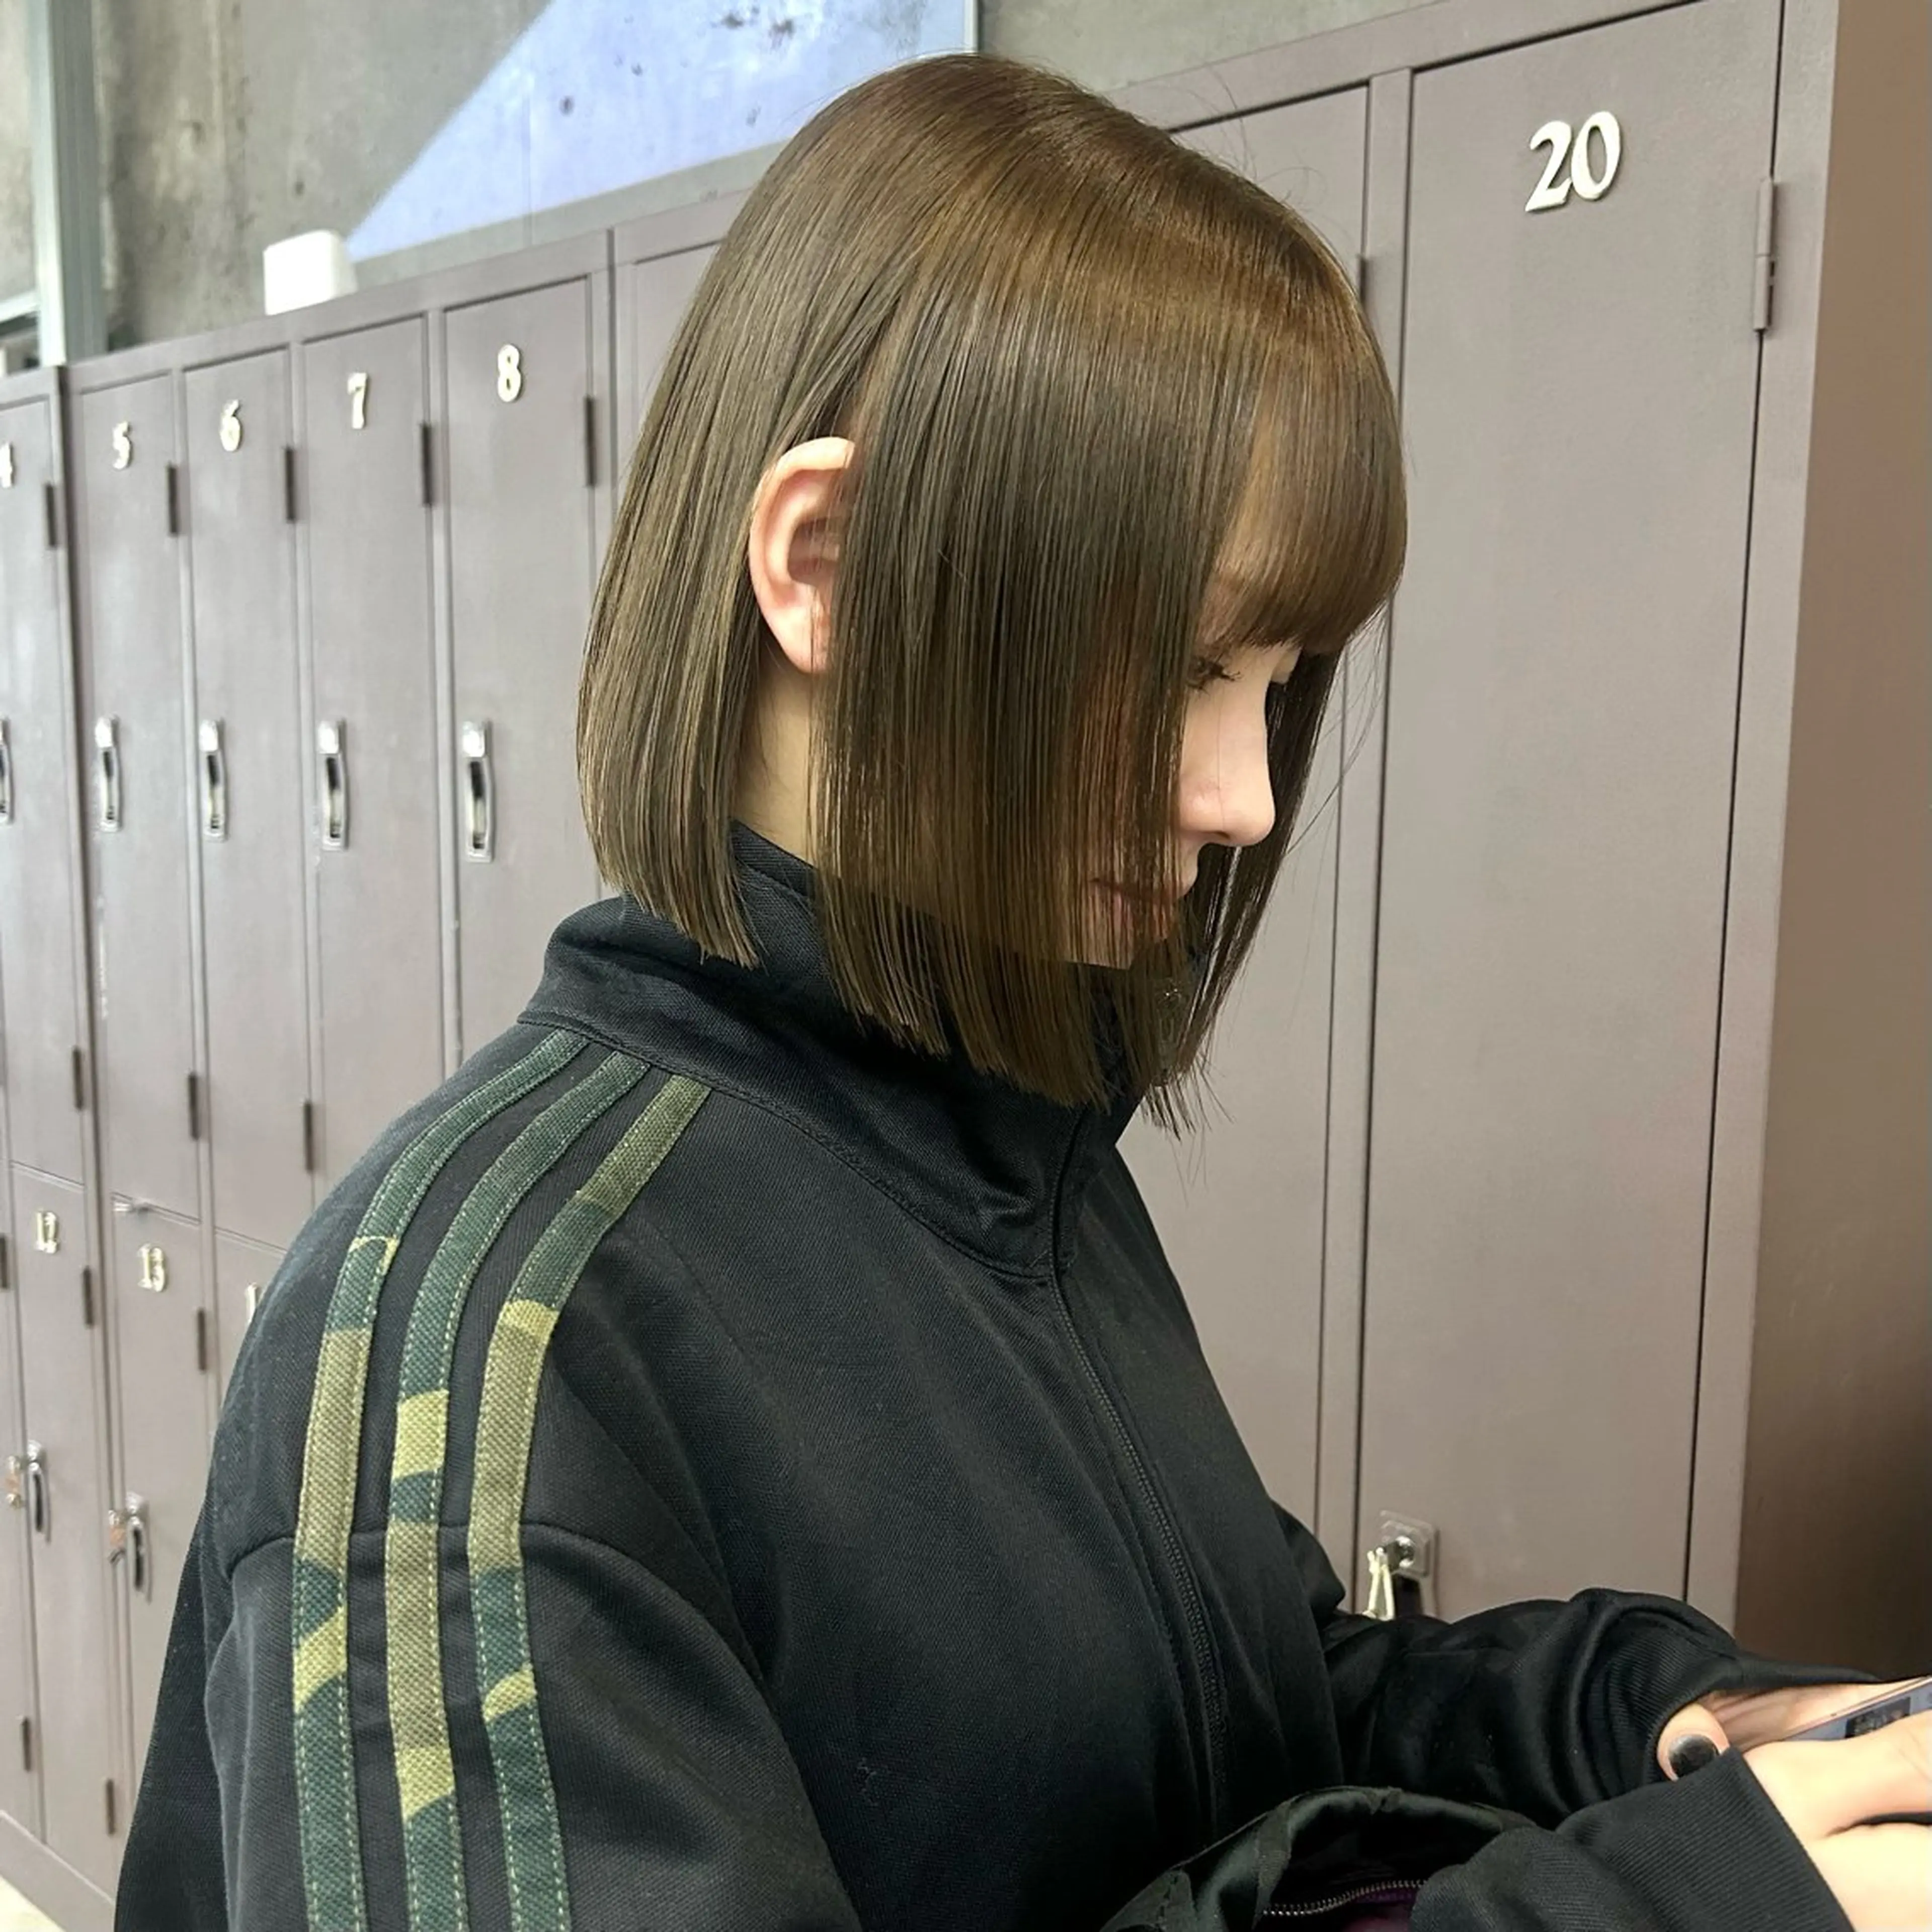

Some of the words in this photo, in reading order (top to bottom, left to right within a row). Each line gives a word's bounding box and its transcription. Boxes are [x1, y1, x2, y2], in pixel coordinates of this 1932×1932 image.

[1525, 111, 1621, 212] 20
[347, 372, 367, 429] 7
[496, 344, 522, 402] 8
[112, 421, 130, 470] 5
[219, 399, 240, 452] 6
[137, 1243, 165, 1292] 13
